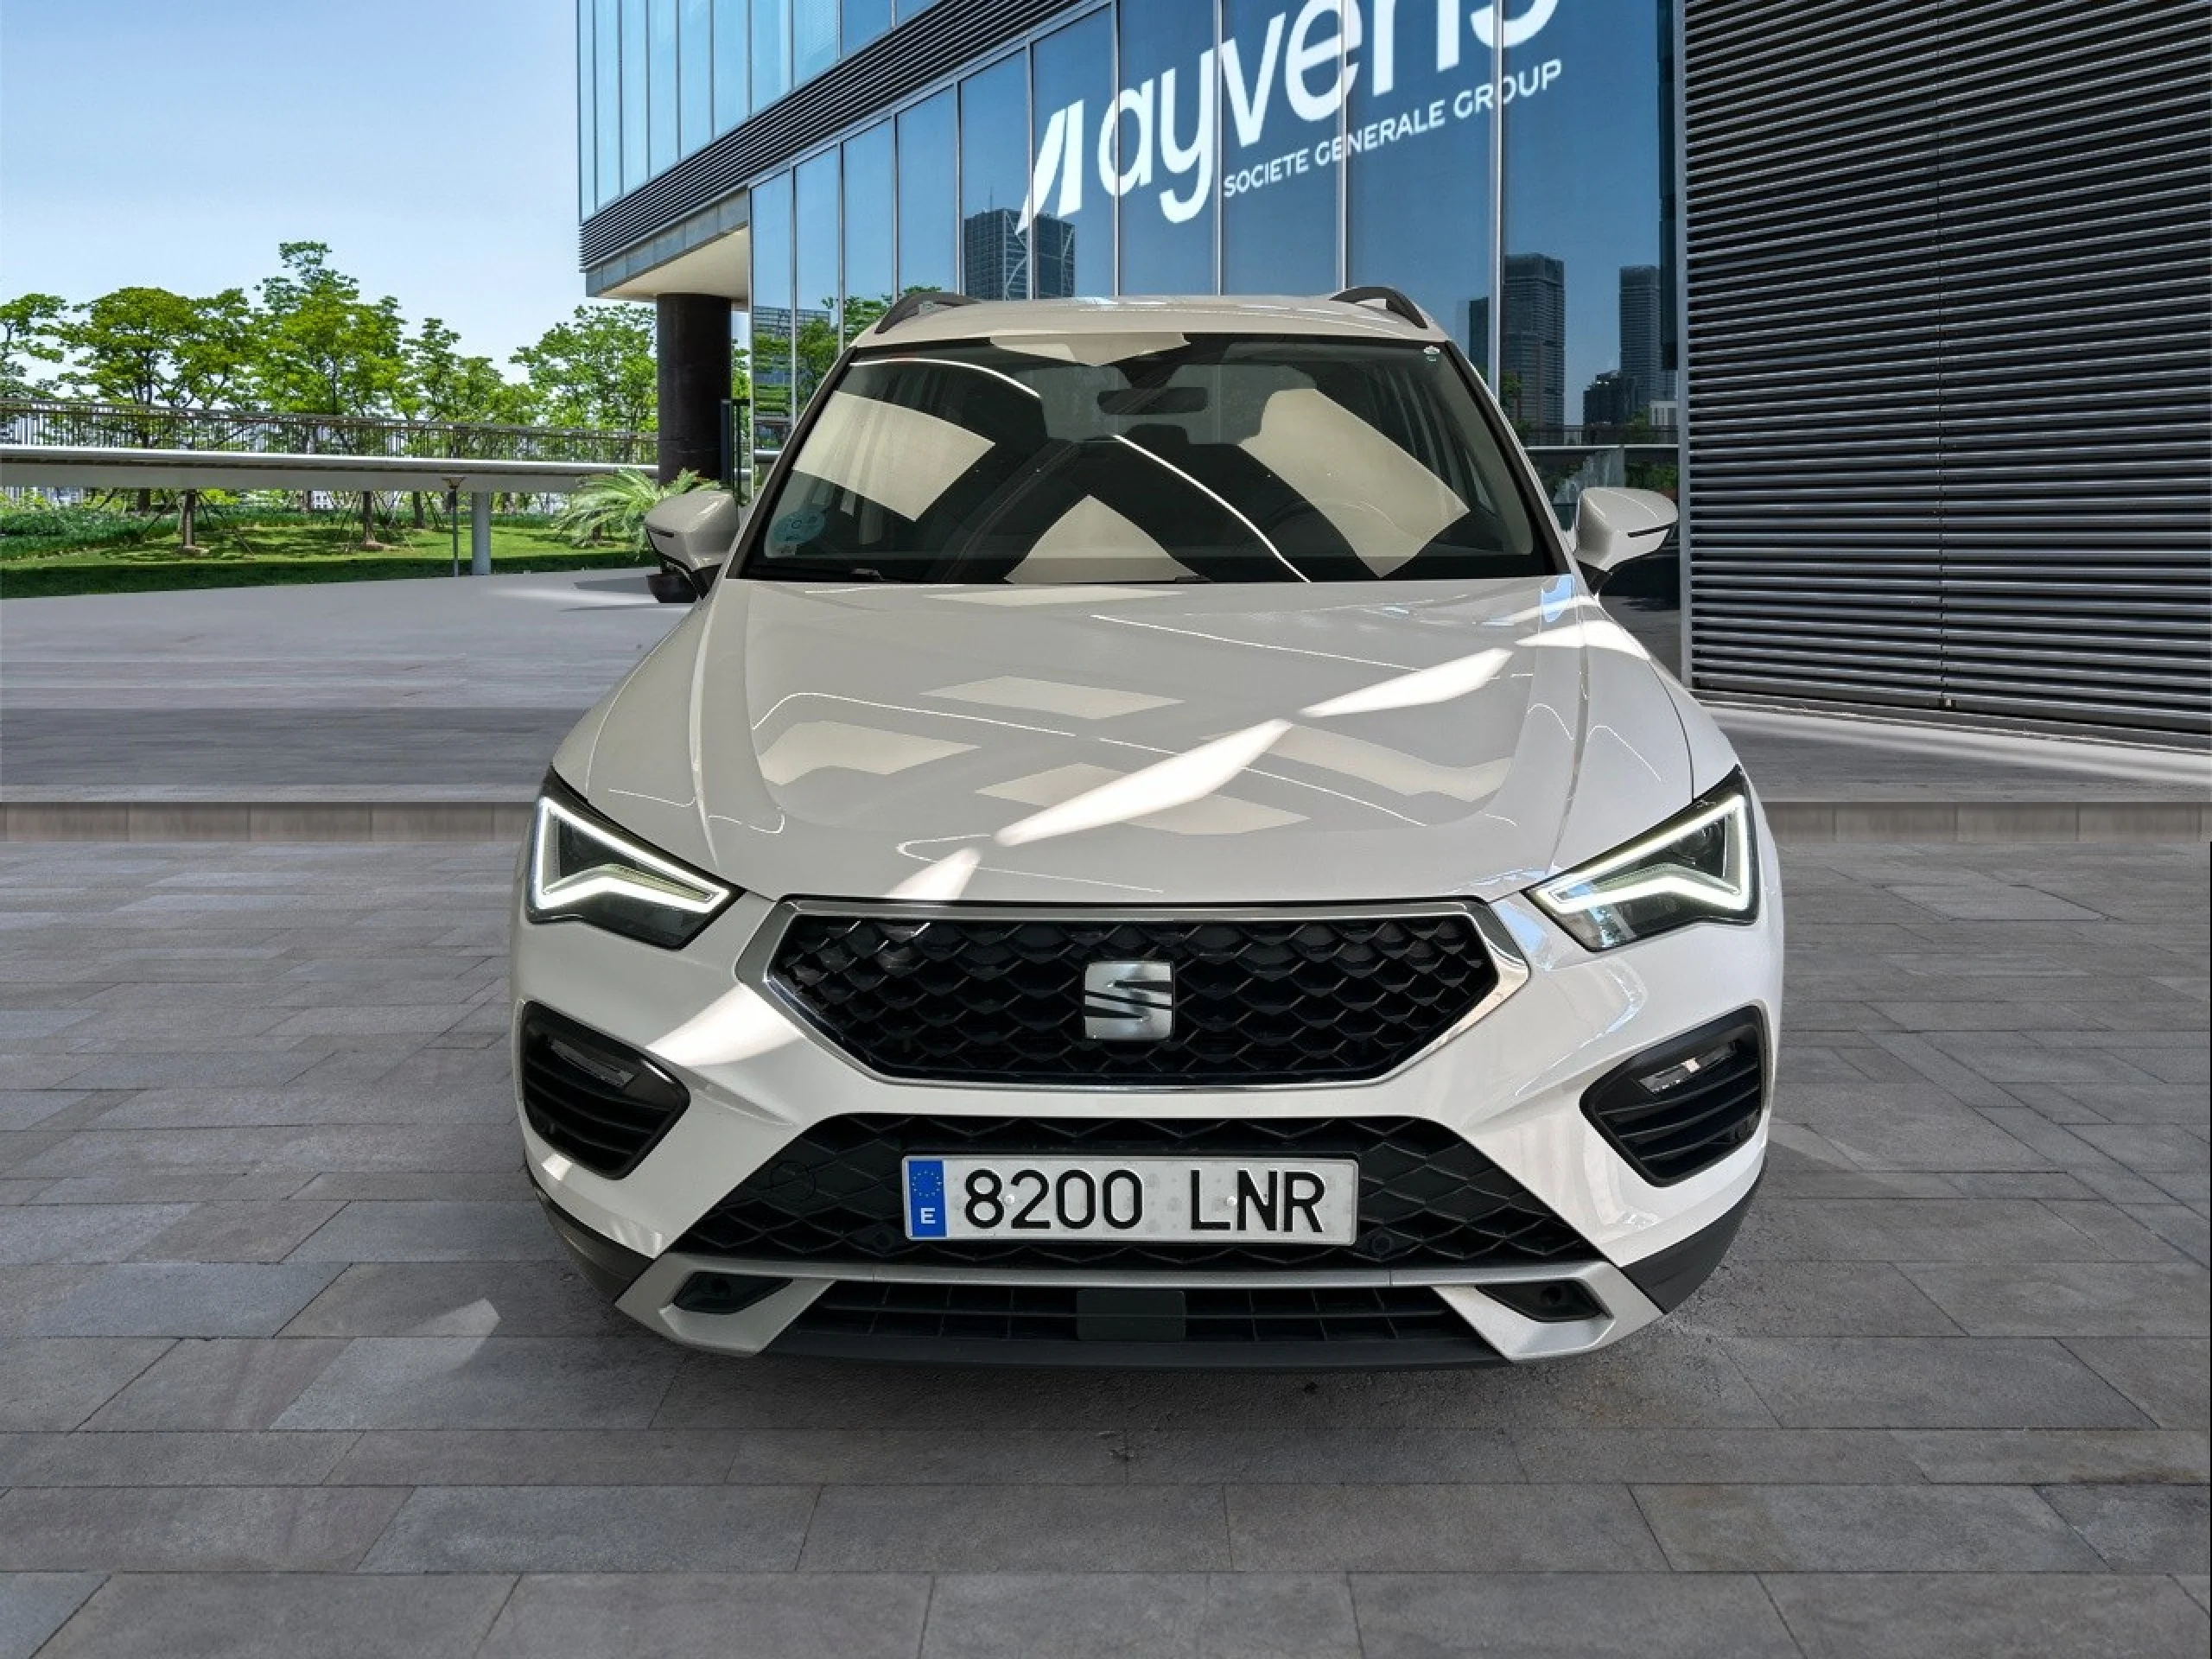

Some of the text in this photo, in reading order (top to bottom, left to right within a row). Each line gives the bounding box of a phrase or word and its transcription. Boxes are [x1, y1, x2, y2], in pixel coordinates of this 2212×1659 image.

[1224, 58, 1563, 197] SOCIETE GENERALE GROUP
[920, 1207, 936, 1224] E
[964, 1169, 1326, 1233] 8200 LNR
